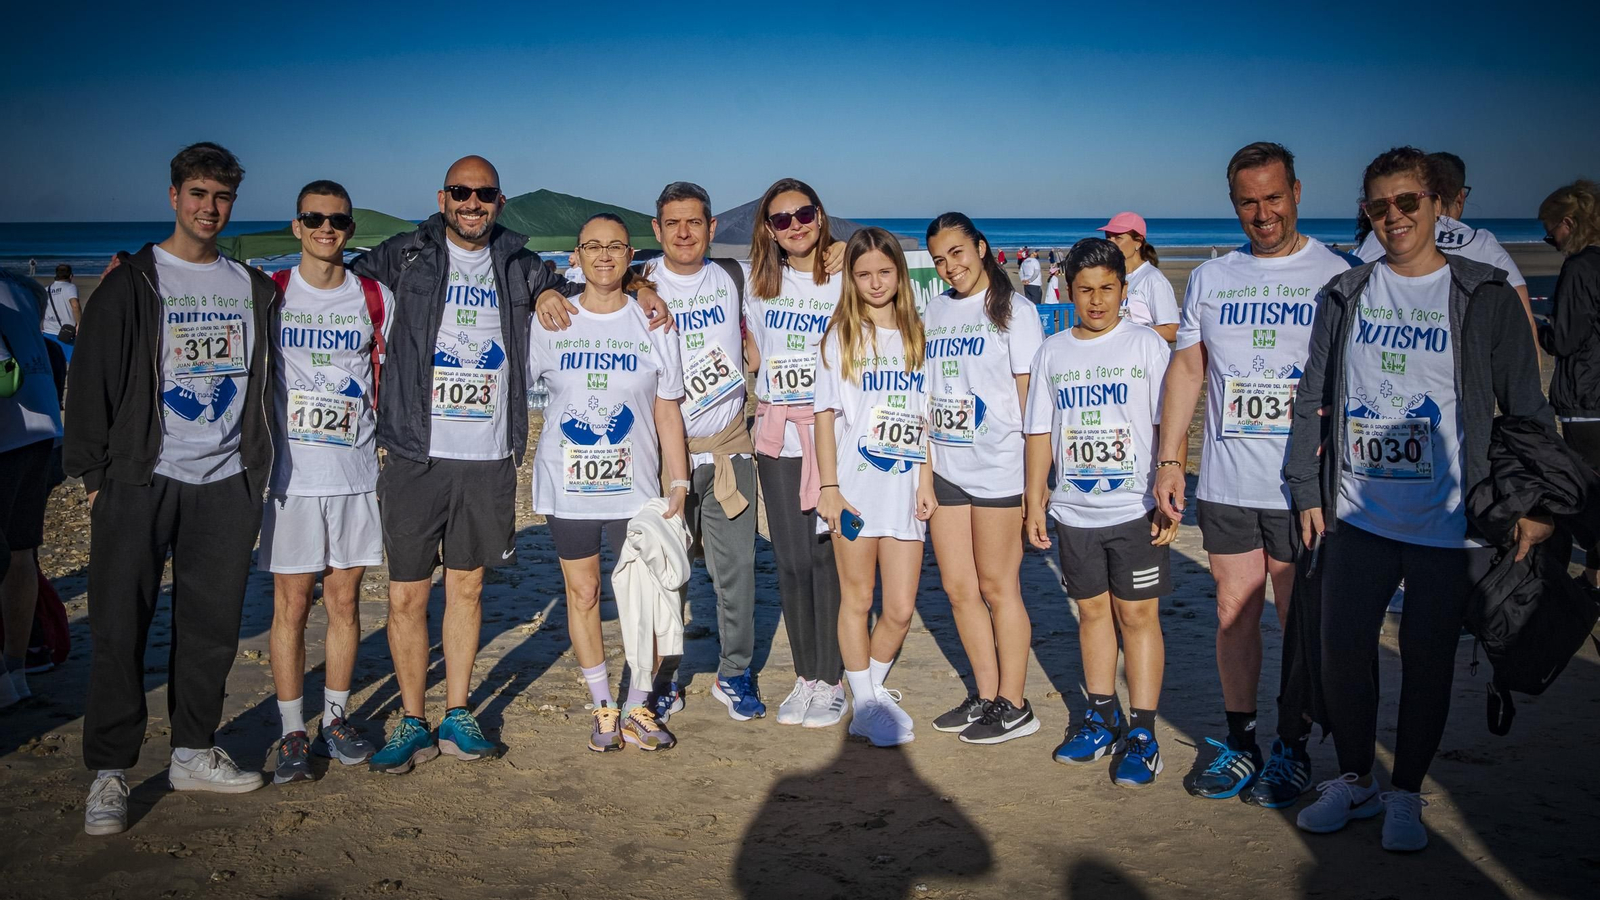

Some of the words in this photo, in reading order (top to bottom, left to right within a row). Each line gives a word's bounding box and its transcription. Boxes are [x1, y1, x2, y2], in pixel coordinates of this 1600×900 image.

[201, 296, 207, 307] a
[212, 294, 239, 308] favor
[243, 296, 255, 309] de
[445, 285, 499, 308] UTISM
[1216, 285, 1257, 299] marcha
[1262, 285, 1270, 297] a
[1276, 284, 1311, 298] favor
[668, 298, 683, 310] cha
[798, 299, 804, 308] a
[808, 298, 835, 311] favor
[1219, 302, 1313, 326] AUTISMO
[318, 314, 324, 324] a
[329, 312, 358, 325] favor
[1410, 308, 1445, 323] favor
[281, 326, 362, 350] AUTISMO
[951, 326, 957, 335] a
[960, 323, 984, 333] favor
[1356, 319, 1448, 353] AUTISMO
[185, 337, 230, 361] 312
[555, 338, 590, 350] marcha
[595, 339, 601, 349] a
[606, 338, 634, 349] favor
[639, 340, 653, 354] del
[560, 352, 637, 371] AUTISMO
[892, 356, 898, 366] a
[684, 358, 730, 401] 1055
[774, 368, 816, 389] 105
[1086, 369, 1092, 380] a
[1096, 365, 1125, 379] favor
[1130, 365, 1146, 379] del
[436, 383, 491, 405] 1023
[1057, 383, 1128, 410] AUTISMO
[1356, 387, 1381, 415] Cada
[1399, 390, 1432, 416] cuenta
[566, 403, 591, 425] Cada
[929, 407, 968, 430] 1032
[1232, 395, 1295, 420] 1031
[295, 406, 351, 432] 1024
[876, 421, 924, 446] 1057
[1069, 441, 1126, 462] 1033
[1355, 436, 1422, 463] 1030
[571, 460, 627, 480] 1022
[1360, 462, 1385, 470] YOLANDA
